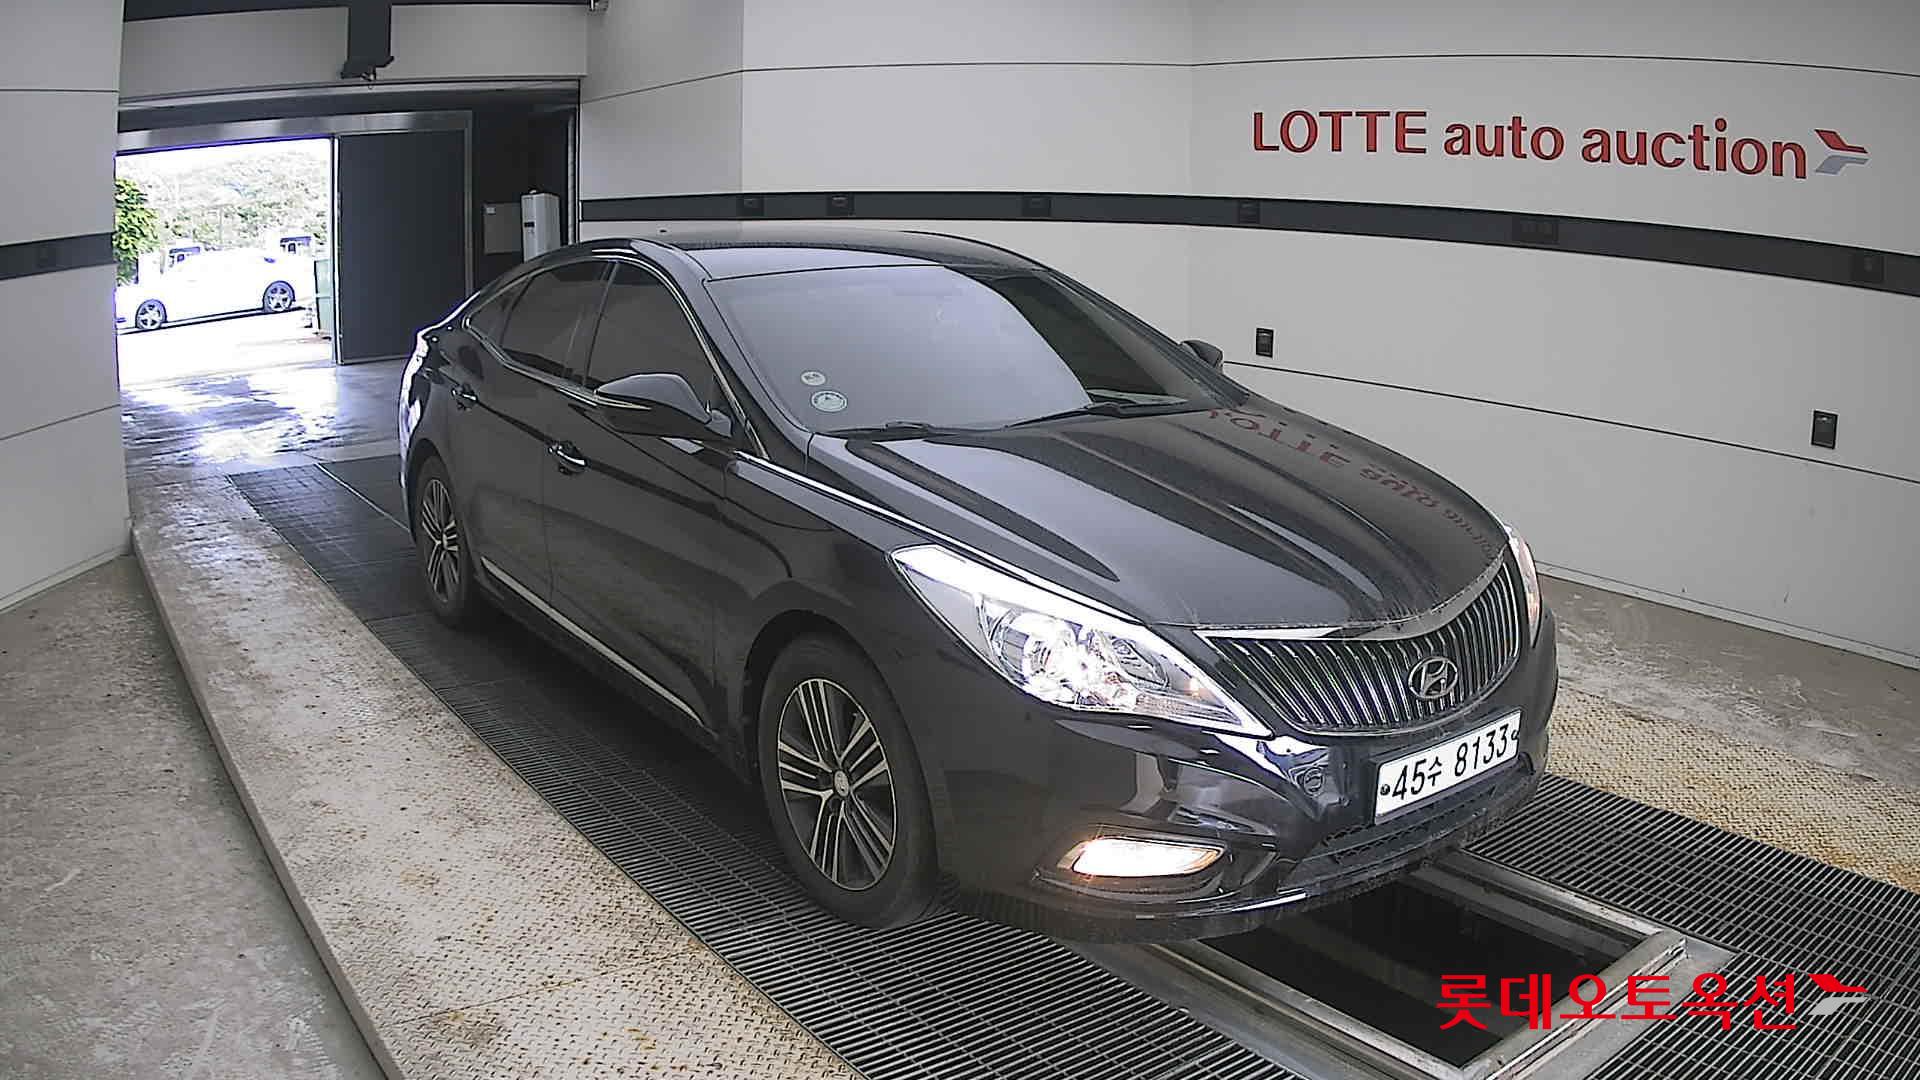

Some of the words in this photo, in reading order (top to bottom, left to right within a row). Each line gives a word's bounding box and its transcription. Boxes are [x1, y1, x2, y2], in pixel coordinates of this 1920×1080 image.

[1253, 111, 1428, 154] LOTTE
[1443, 116, 1566, 161] auto
[1582, 118, 1808, 180] auction
[1391, 756, 1443, 801] 45수
[1453, 723, 1511, 778] 8133
